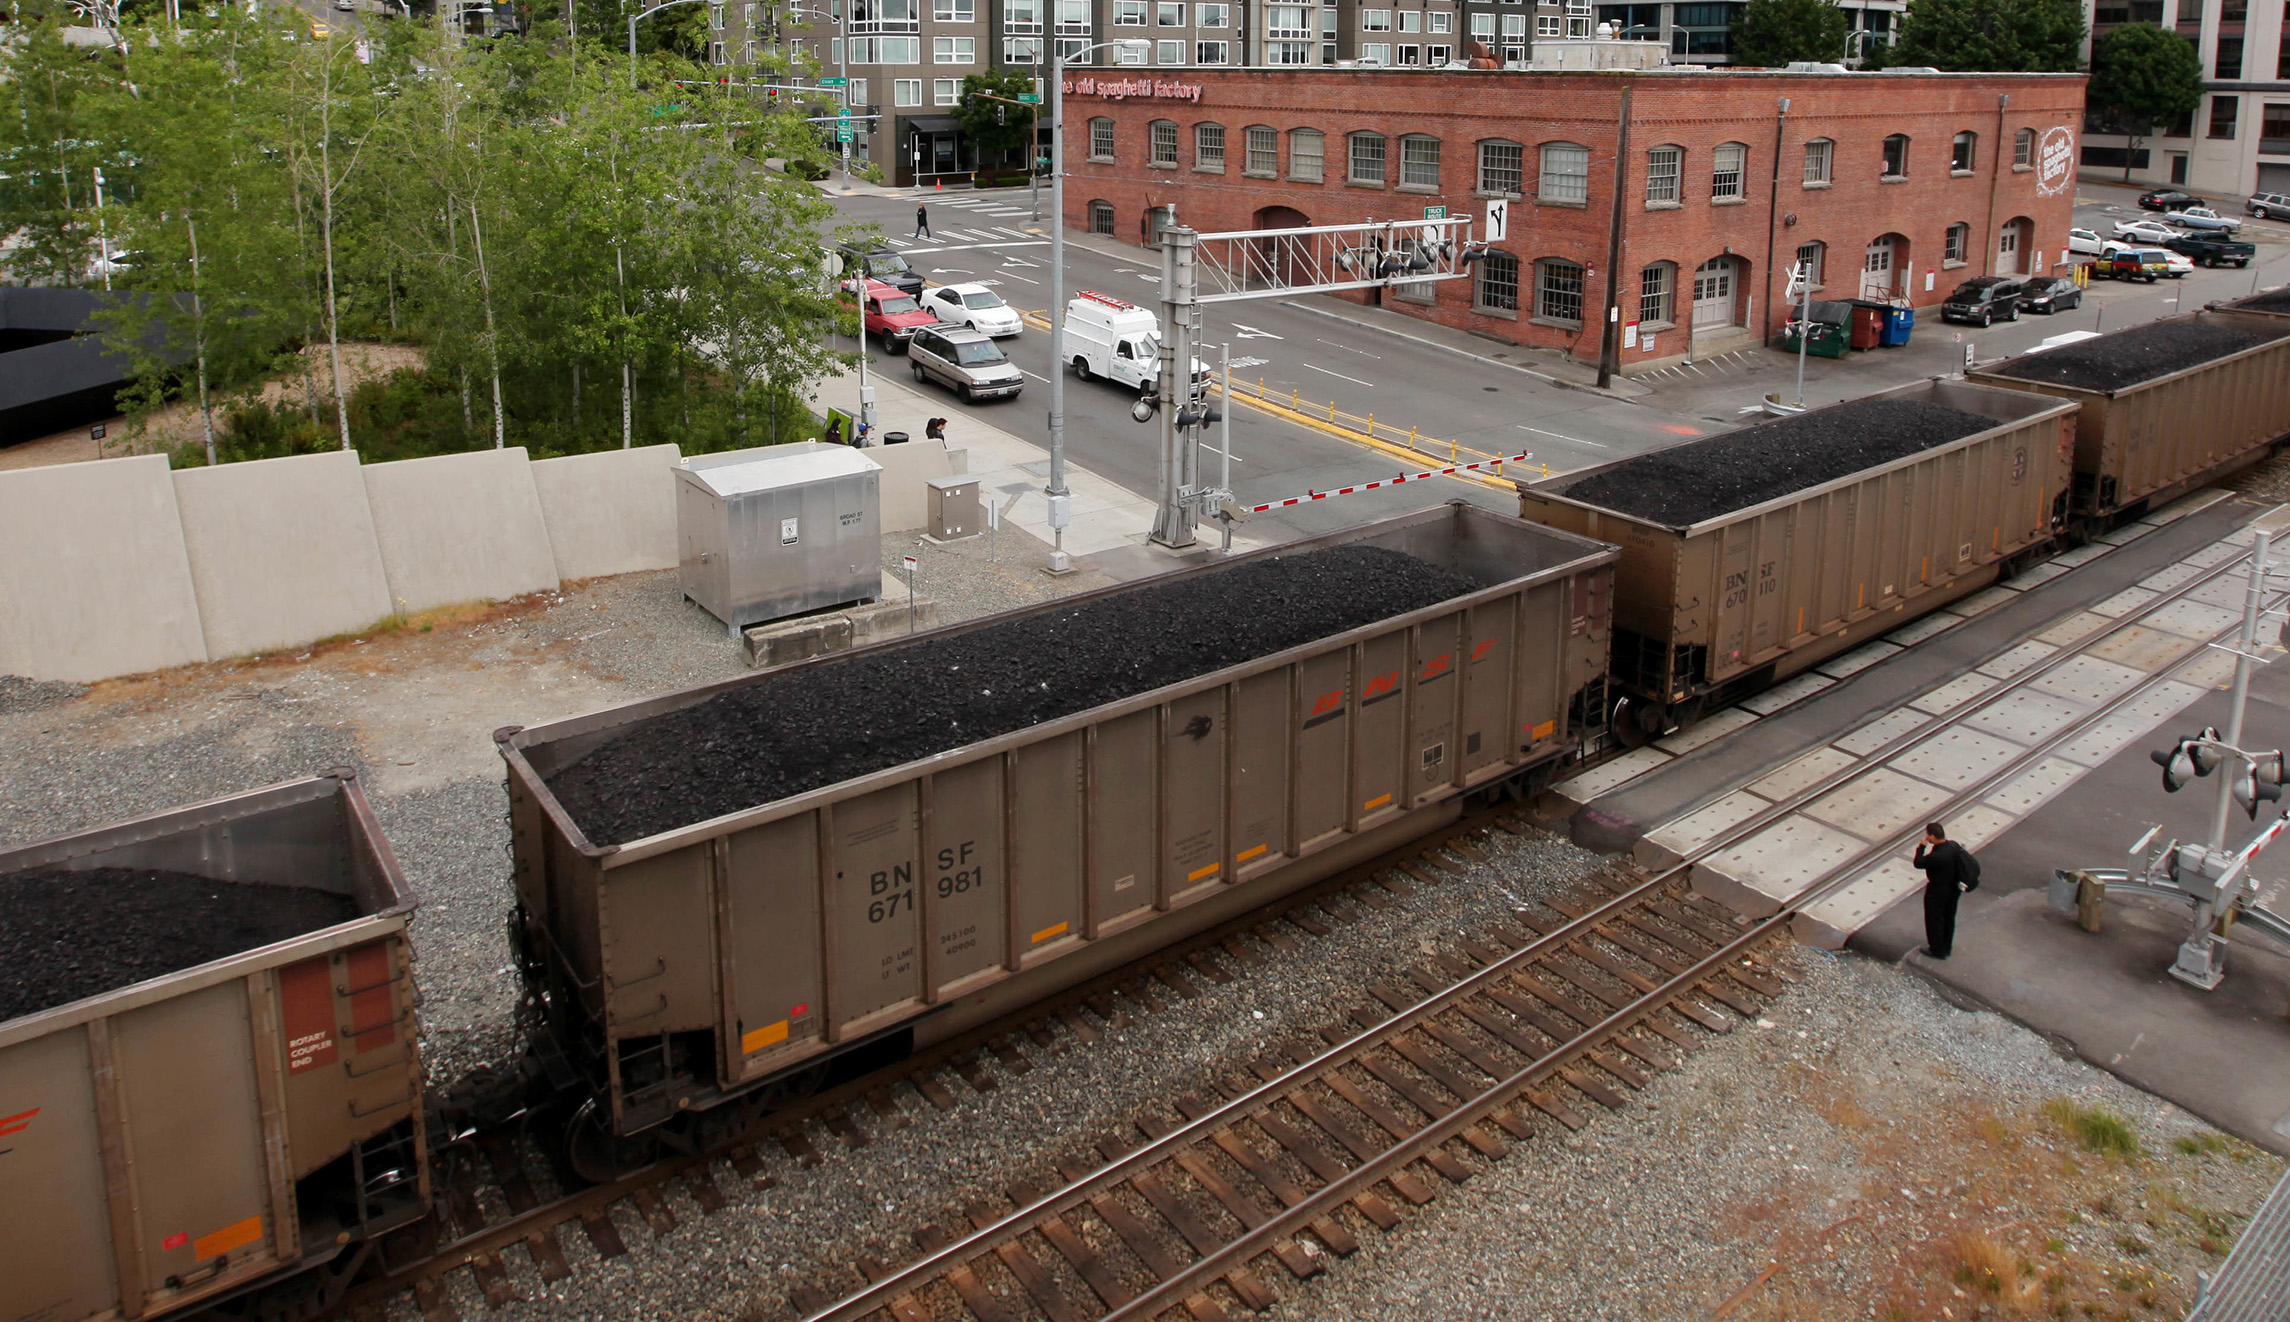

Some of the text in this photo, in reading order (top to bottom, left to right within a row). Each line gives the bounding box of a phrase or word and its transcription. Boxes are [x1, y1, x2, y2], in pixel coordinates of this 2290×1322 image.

[1075, 77, 1094, 95] old
[1096, 77, 1152, 100] spaghetti
[1153, 79, 1202, 103] factory
[2043, 136, 2065, 158] the old
[2043, 144, 2071, 170] spaghetti
[2043, 161, 2066, 182] factory
[840, 512, 857, 521] BROAD
[1725, 569, 1749, 591] BN
[1725, 589, 1746, 609] 670
[869, 840, 975, 896] BN SF
[867, 866, 982, 924] 671 981
[289, 1030, 327, 1049] ROTARY
[290, 1039, 333, 1058] COUPLER
[291, 1056, 313, 1069] END
